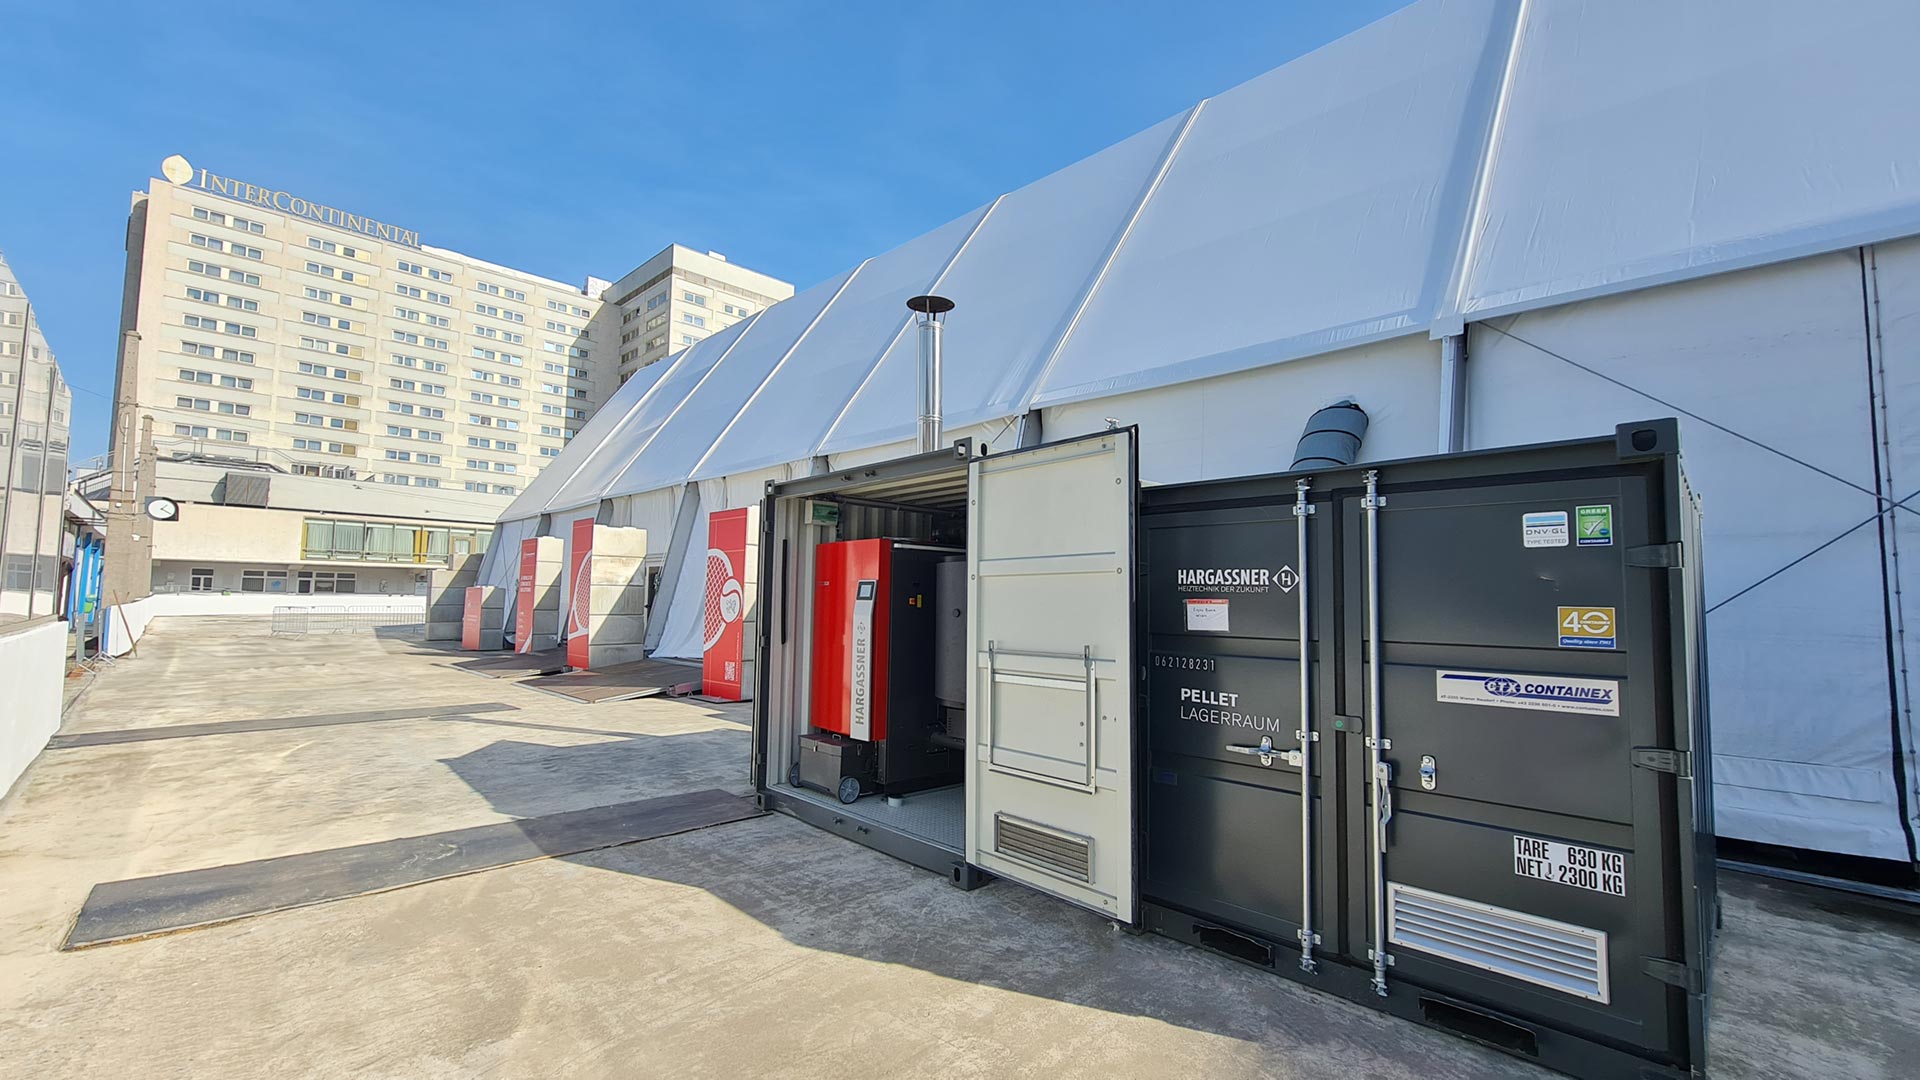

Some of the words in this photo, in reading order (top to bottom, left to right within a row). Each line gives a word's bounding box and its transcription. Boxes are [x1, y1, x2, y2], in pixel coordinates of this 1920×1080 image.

[1177, 569, 1270, 586] HARGASSNER
[1177, 585, 1220, 593] HEIZTECHNIK
[1220, 585, 1235, 593] DER
[1563, 611, 1609, 634] 40
[1155, 655, 1215, 671] 062128231
[855, 638, 866, 725] HARGASSNER
[1524, 683, 1613, 700] CONTAINEX
[1181, 687, 1238, 708] PELLET
[1180, 705, 1280, 733] LAGERRAUM
[1515, 837, 1550, 860] TARE
[1567, 846, 1597, 869] 630
[1601, 852, 1622, 874] KG
[1516, 856, 1543, 878] NET
[1558, 864, 1598, 890] 2300
[1602, 873, 1623, 895] KG
